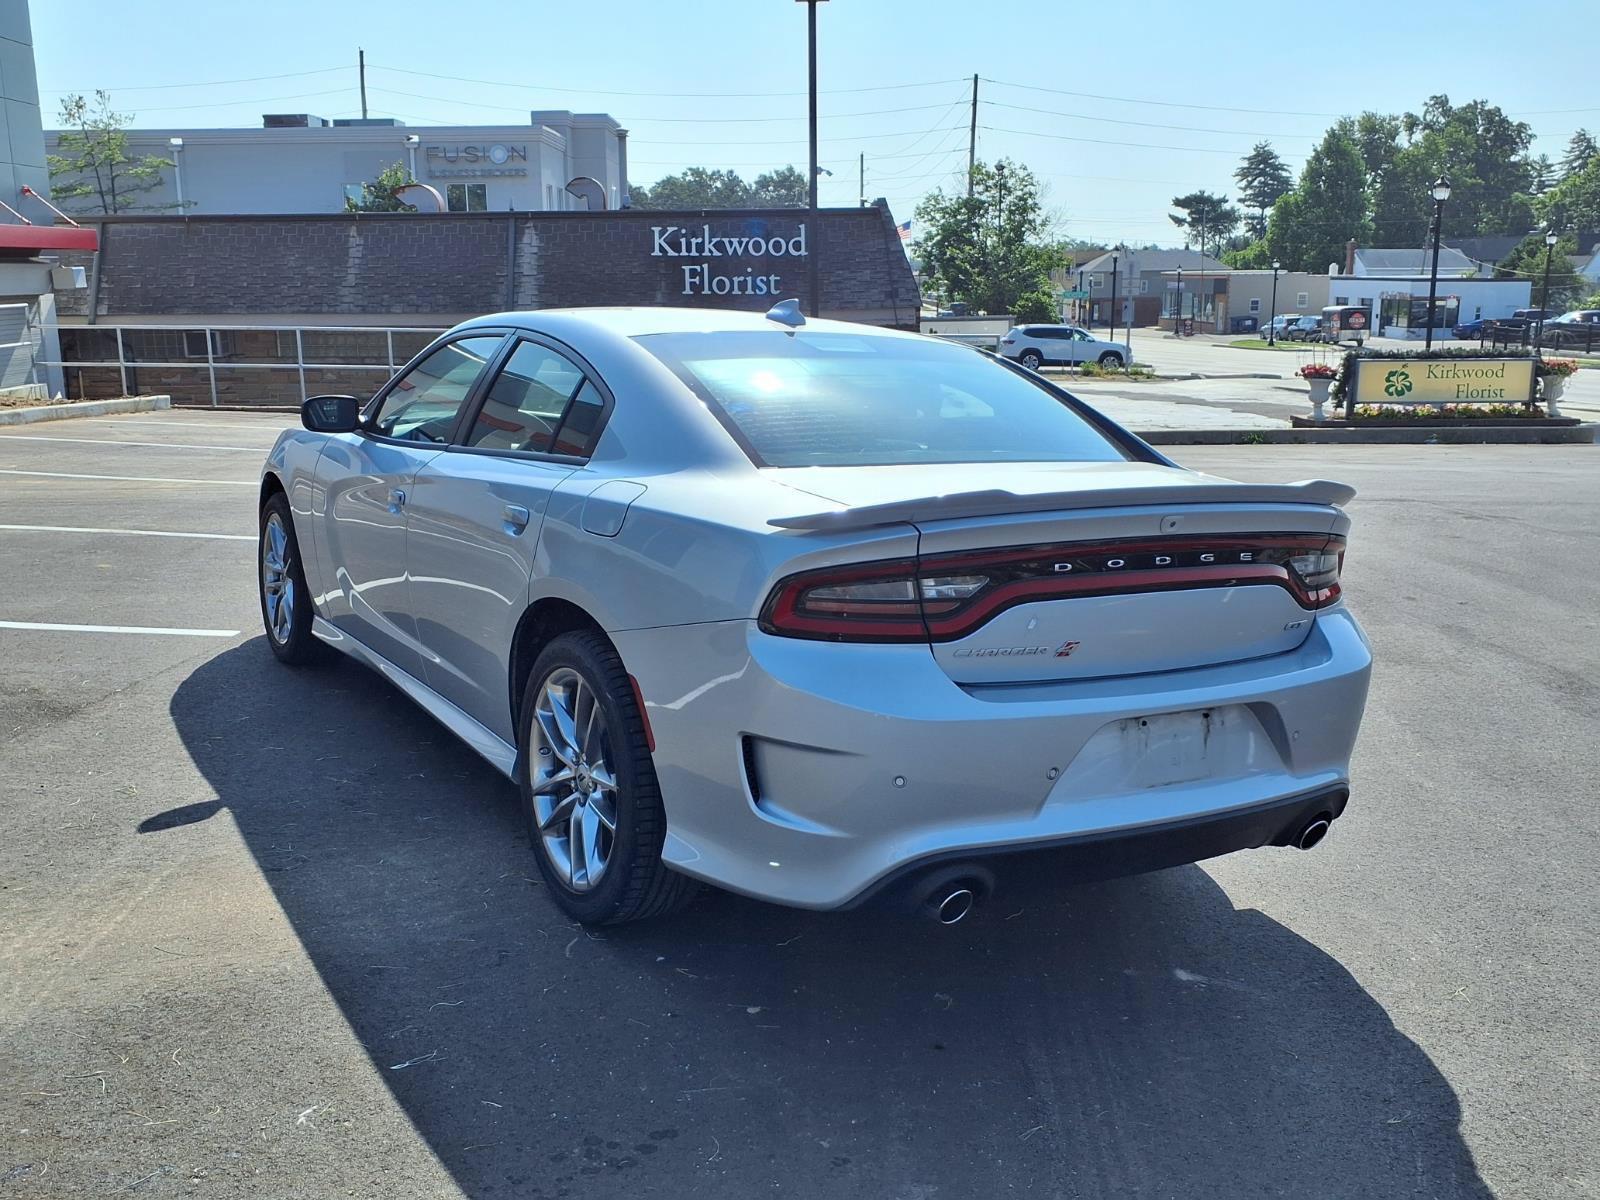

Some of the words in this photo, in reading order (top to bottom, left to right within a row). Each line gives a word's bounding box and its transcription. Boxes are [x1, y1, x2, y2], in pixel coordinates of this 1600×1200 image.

[426, 144, 527, 164] FUSION
[650, 224, 808, 256] Kirkwood
[681, 264, 781, 295] Florist
[1426, 362, 1505, 379] Kirkwood
[1456, 383, 1505, 398] Florist
[1054, 552, 1253, 572] DODGE
